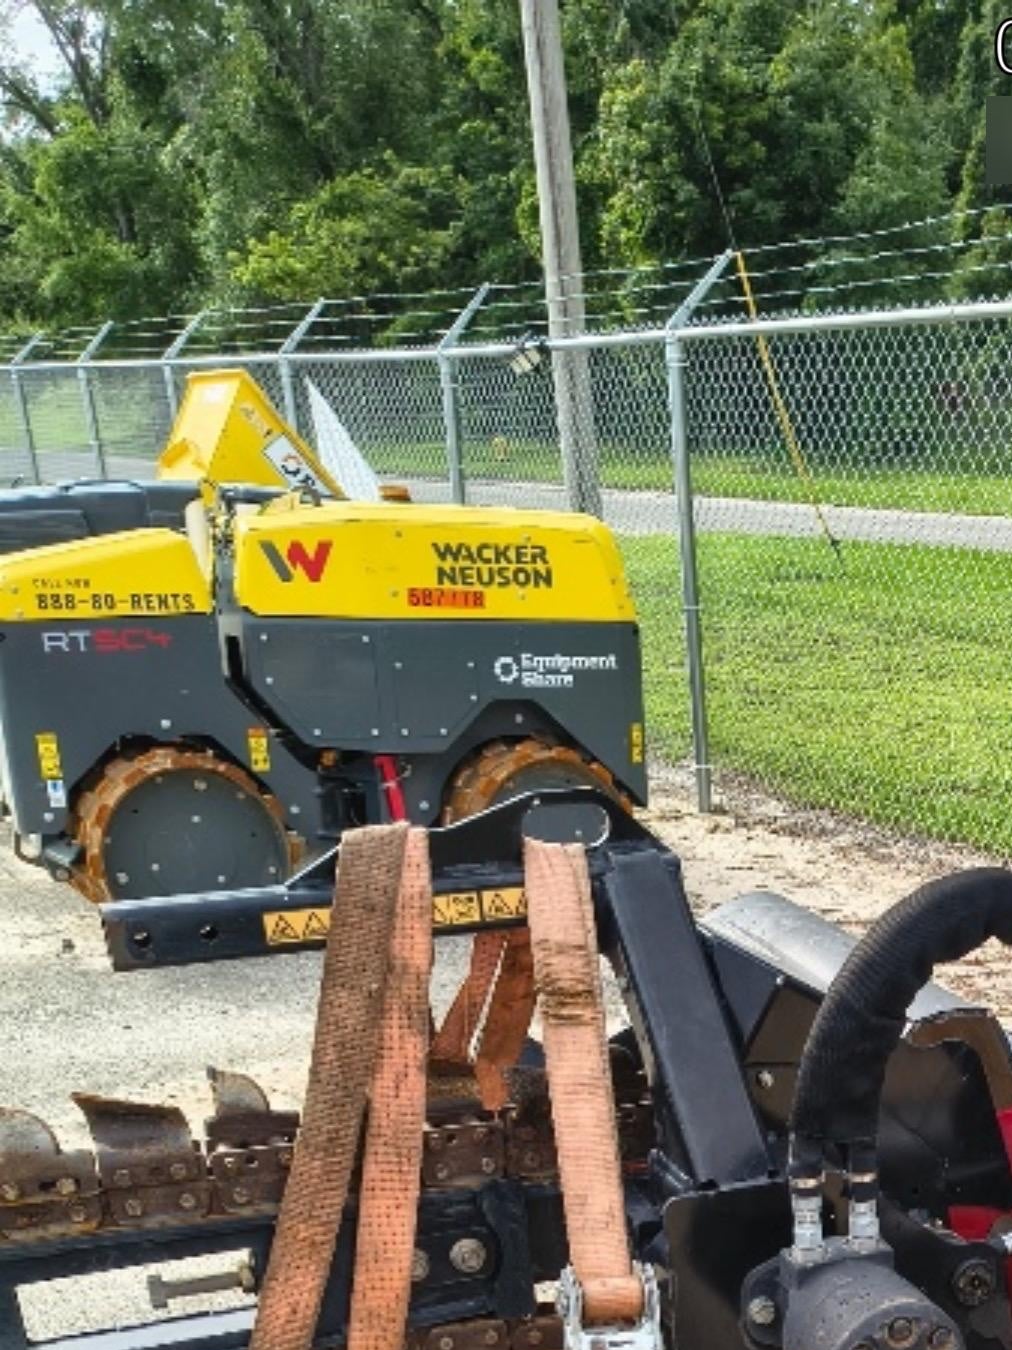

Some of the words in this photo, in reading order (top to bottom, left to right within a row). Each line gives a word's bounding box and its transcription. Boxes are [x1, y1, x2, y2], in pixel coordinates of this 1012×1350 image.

[432, 543, 549, 564] WACKER
[437, 566, 553, 588] NEUSON
[36, 592, 195, 611] 888-80-RENTS
[521, 653, 618, 672] Equipment
[521, 672, 573, 687] Share
